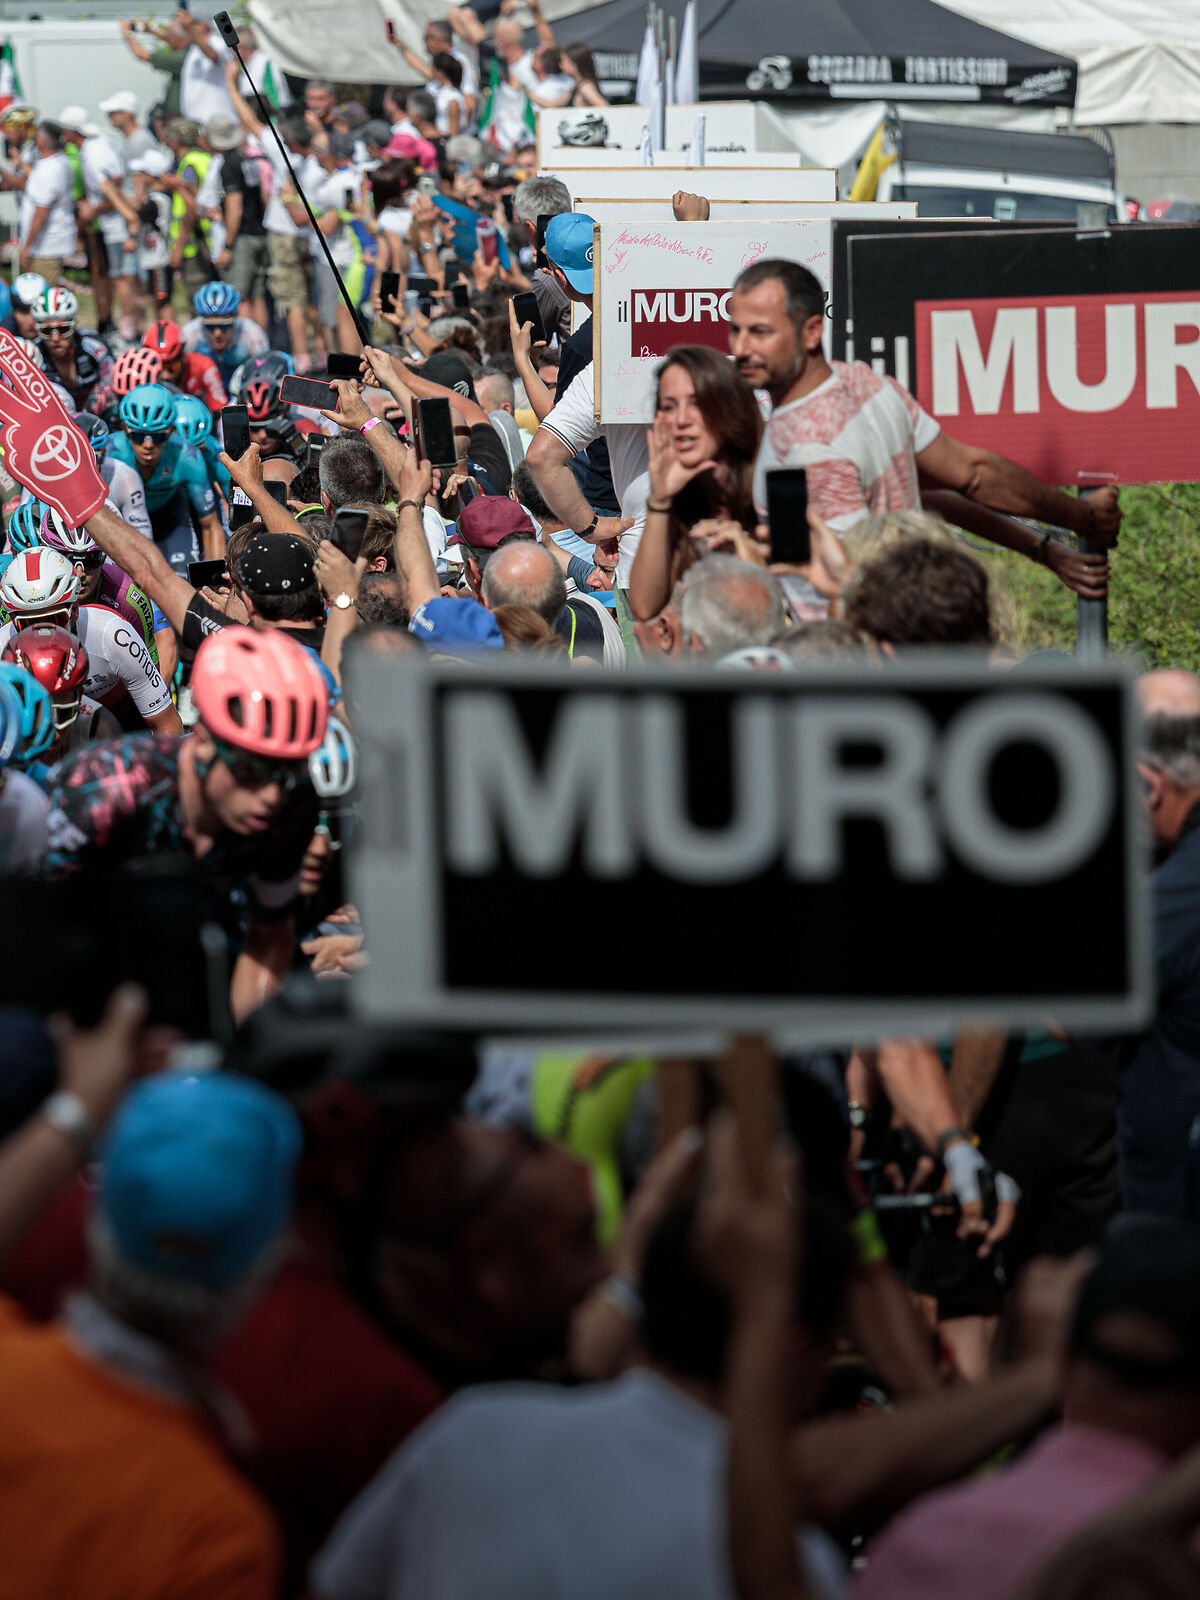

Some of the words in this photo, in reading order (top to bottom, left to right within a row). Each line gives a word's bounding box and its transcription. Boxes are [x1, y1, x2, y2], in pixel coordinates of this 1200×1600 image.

[617, 301, 628, 322] il
[137, 596, 153, 642] FAIZAN
[113, 628, 161, 688] Cofidis
[79, 703, 94, 716] 42
[445, 694, 1113, 880] MURO
